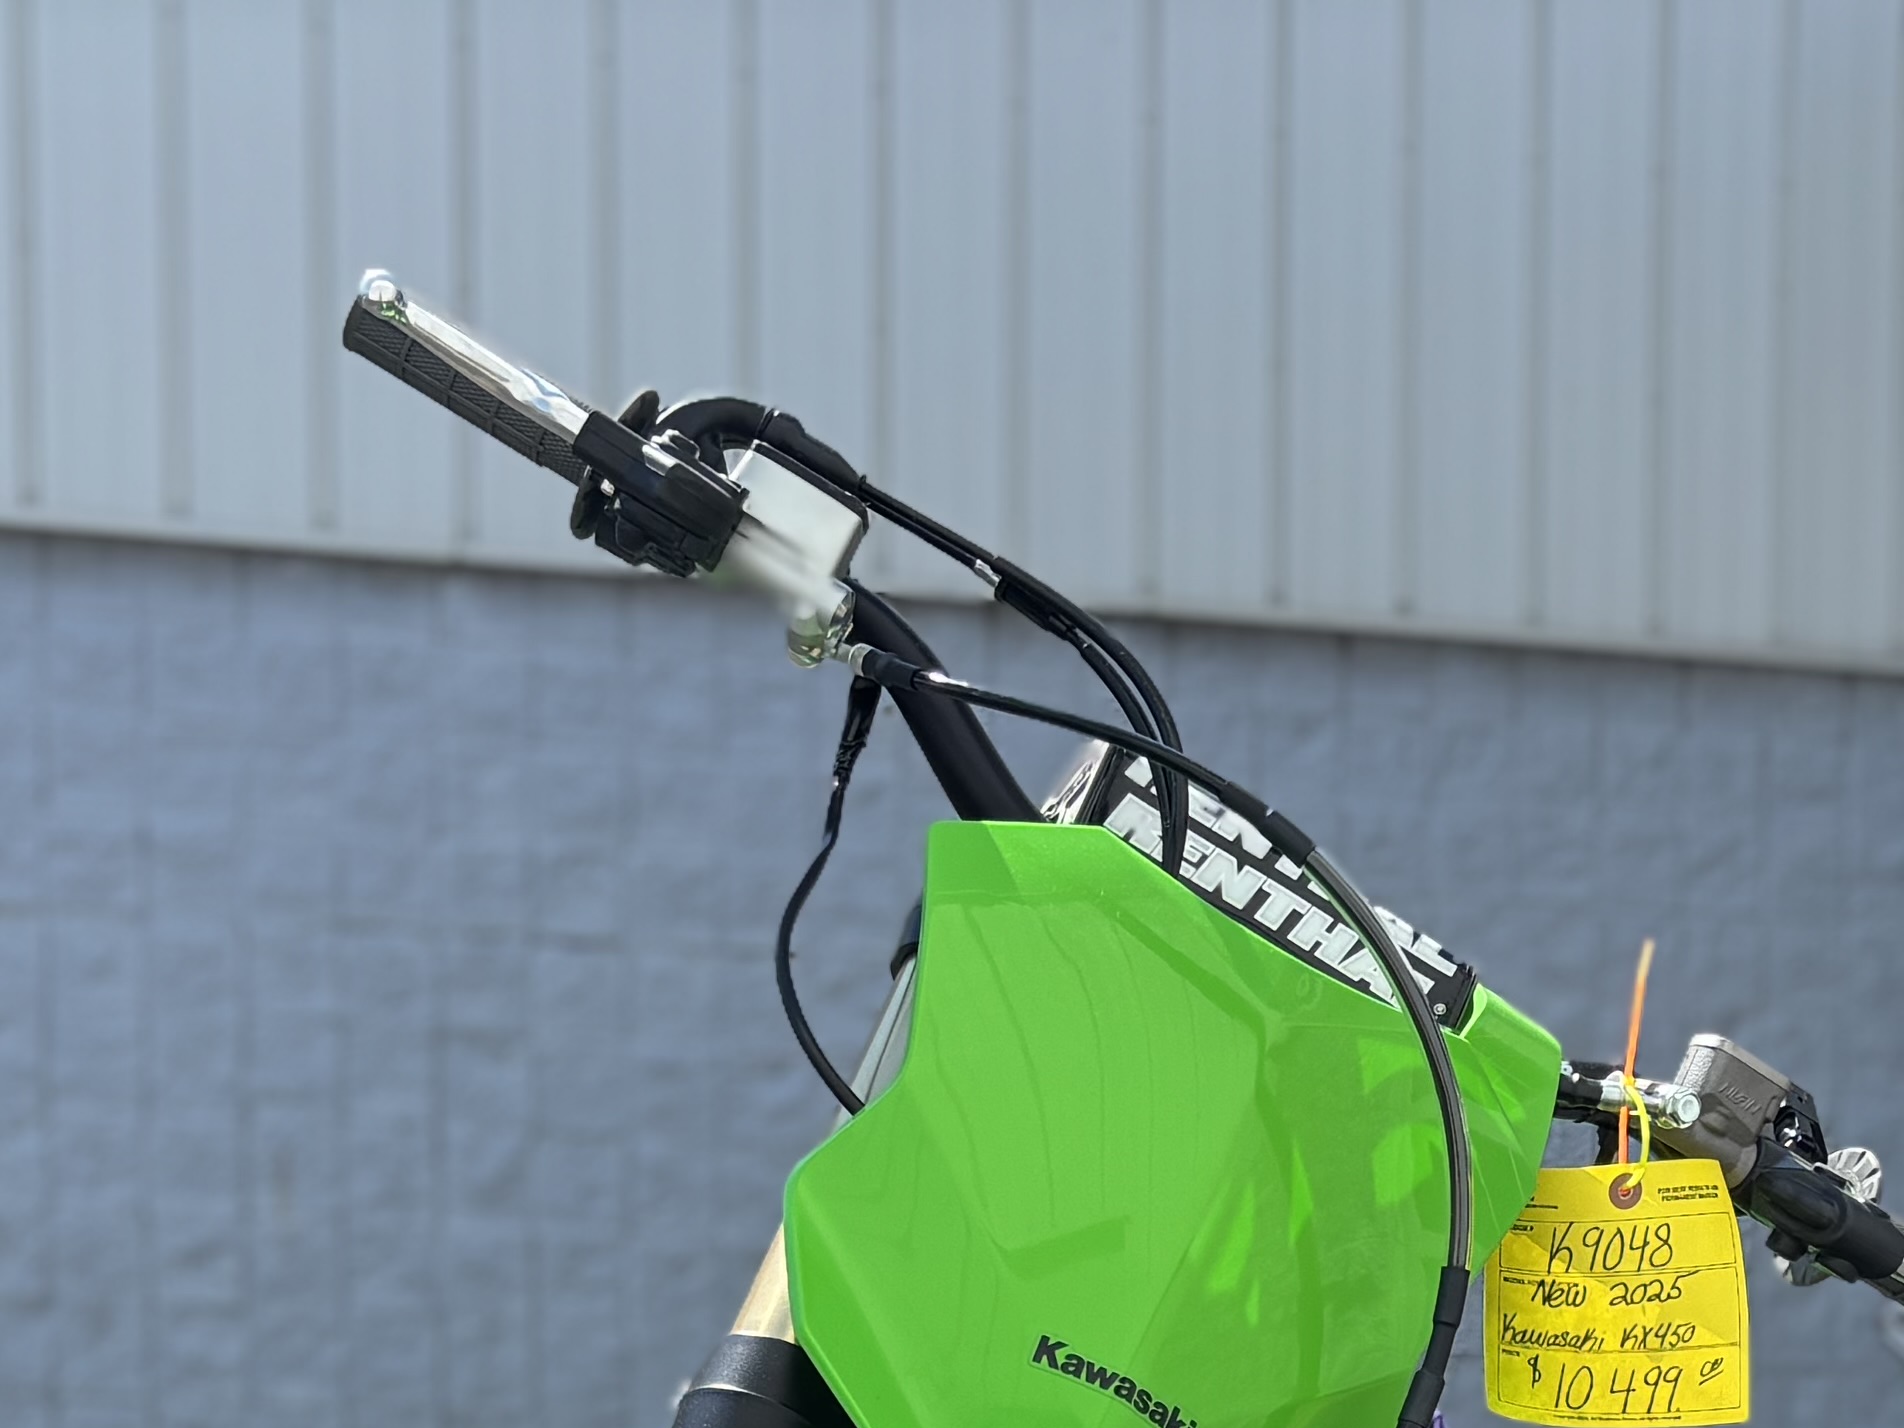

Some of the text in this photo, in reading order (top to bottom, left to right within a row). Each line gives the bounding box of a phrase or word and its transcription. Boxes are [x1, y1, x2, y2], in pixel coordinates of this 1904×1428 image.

[1102, 792, 1436, 1012] RENTHA
[1547, 1221, 1673, 1275] K9048
[1609, 1269, 1702, 1307] 2025
[1619, 1322, 1696, 1350] KX450
